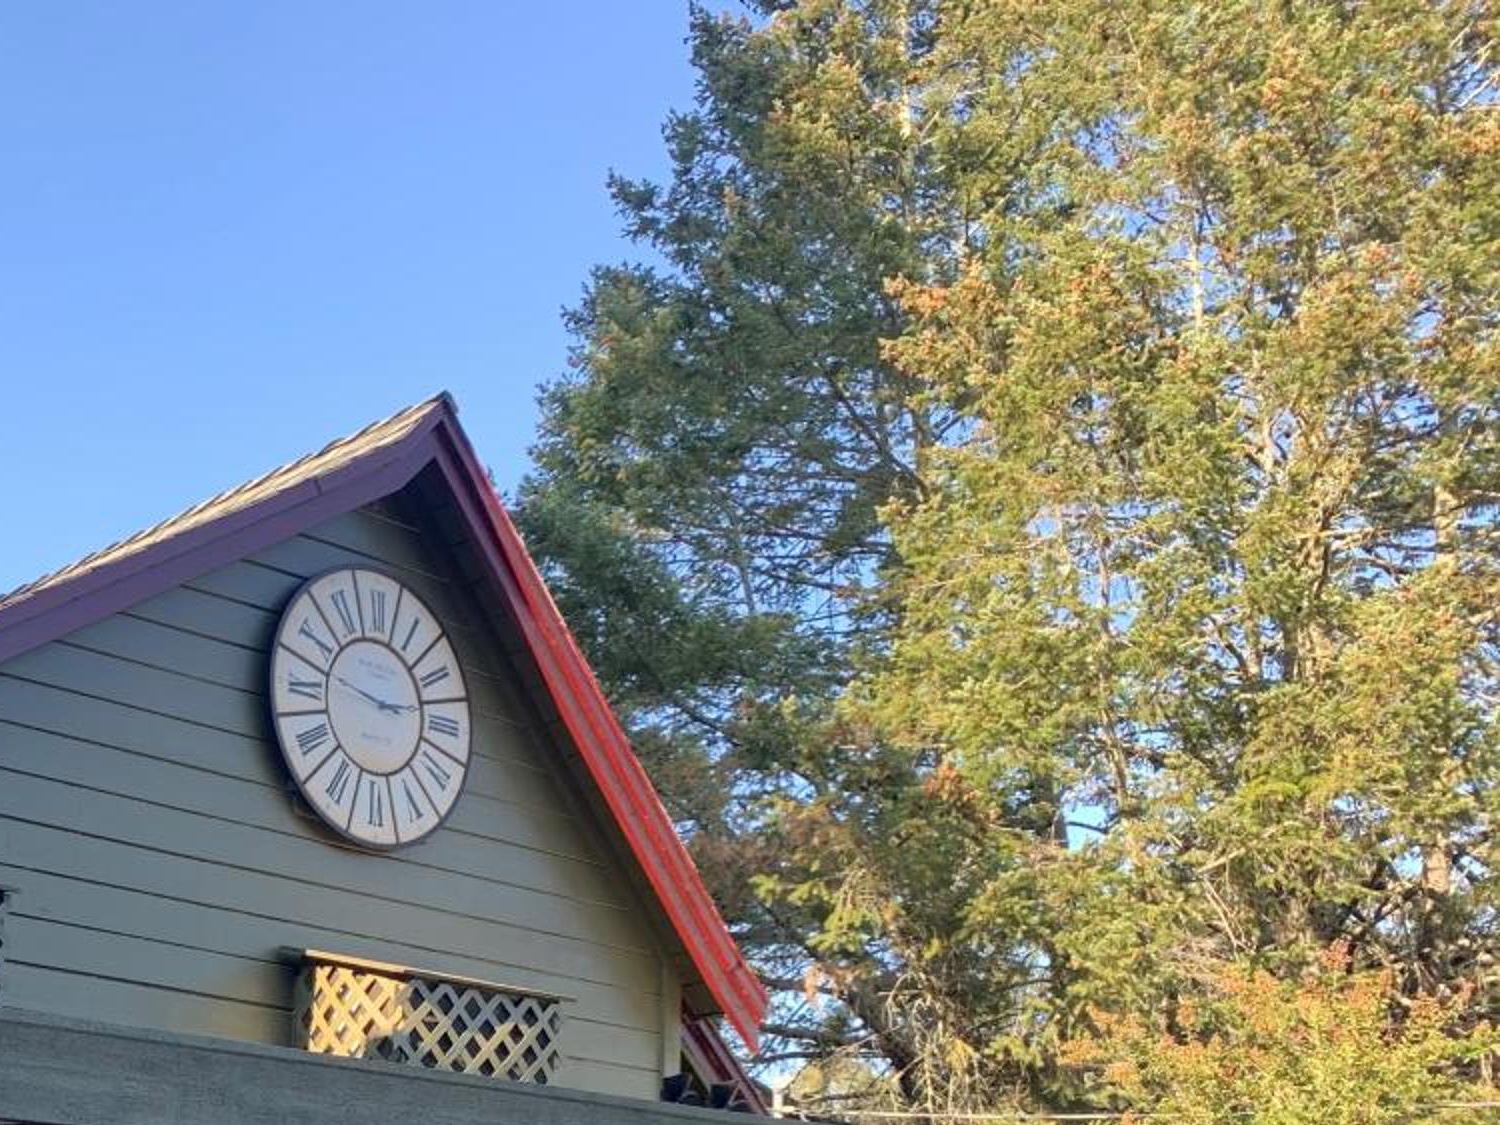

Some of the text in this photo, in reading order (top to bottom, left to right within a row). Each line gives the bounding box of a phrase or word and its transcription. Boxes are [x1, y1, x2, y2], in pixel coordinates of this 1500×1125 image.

[401, 616, 420, 651] I
[418, 665, 451, 689] II
[427, 713, 460, 739] III
